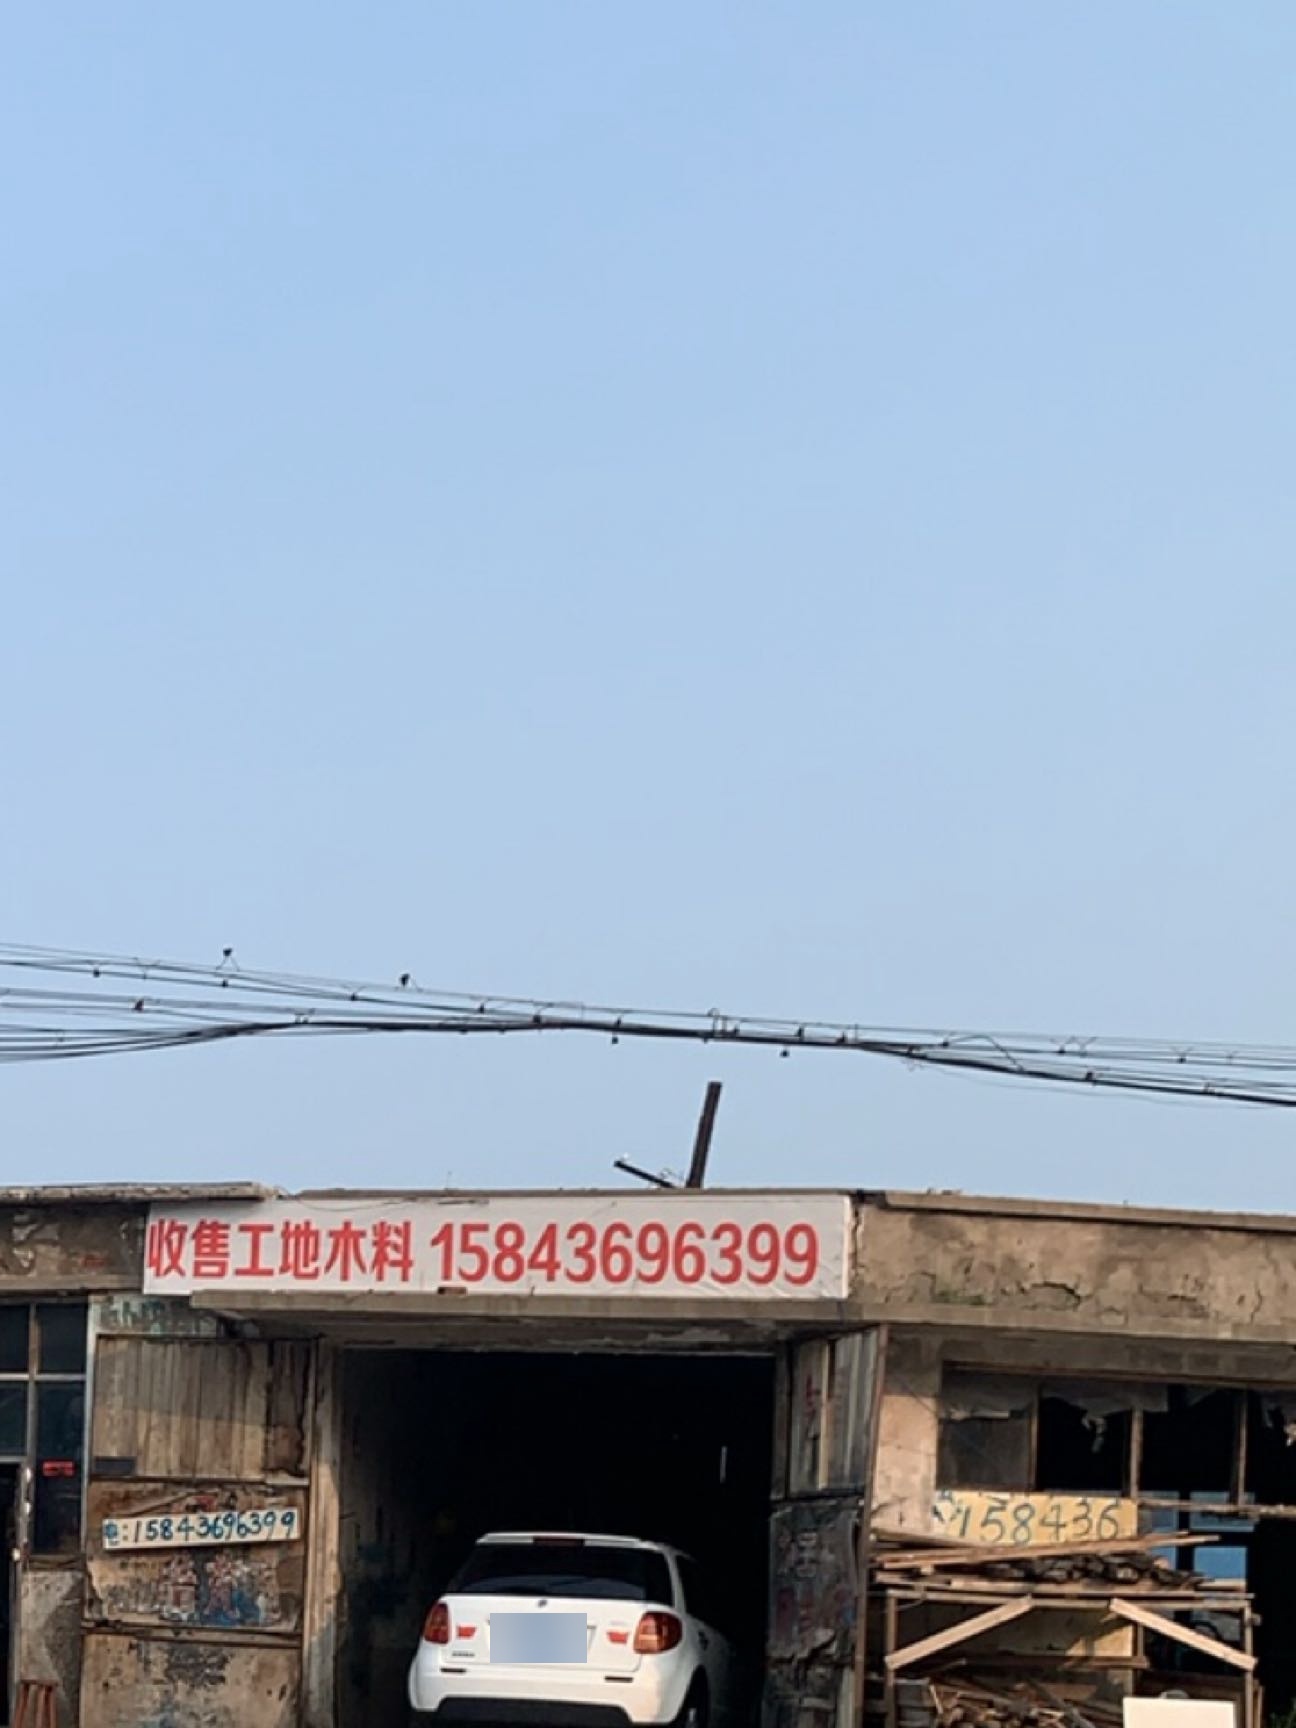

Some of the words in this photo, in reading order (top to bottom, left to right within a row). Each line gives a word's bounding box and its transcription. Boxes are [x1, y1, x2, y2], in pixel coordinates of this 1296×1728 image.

[146, 1218, 413, 1282] 收售工地木料
[430, 1222, 820, 1285] 15843696399
